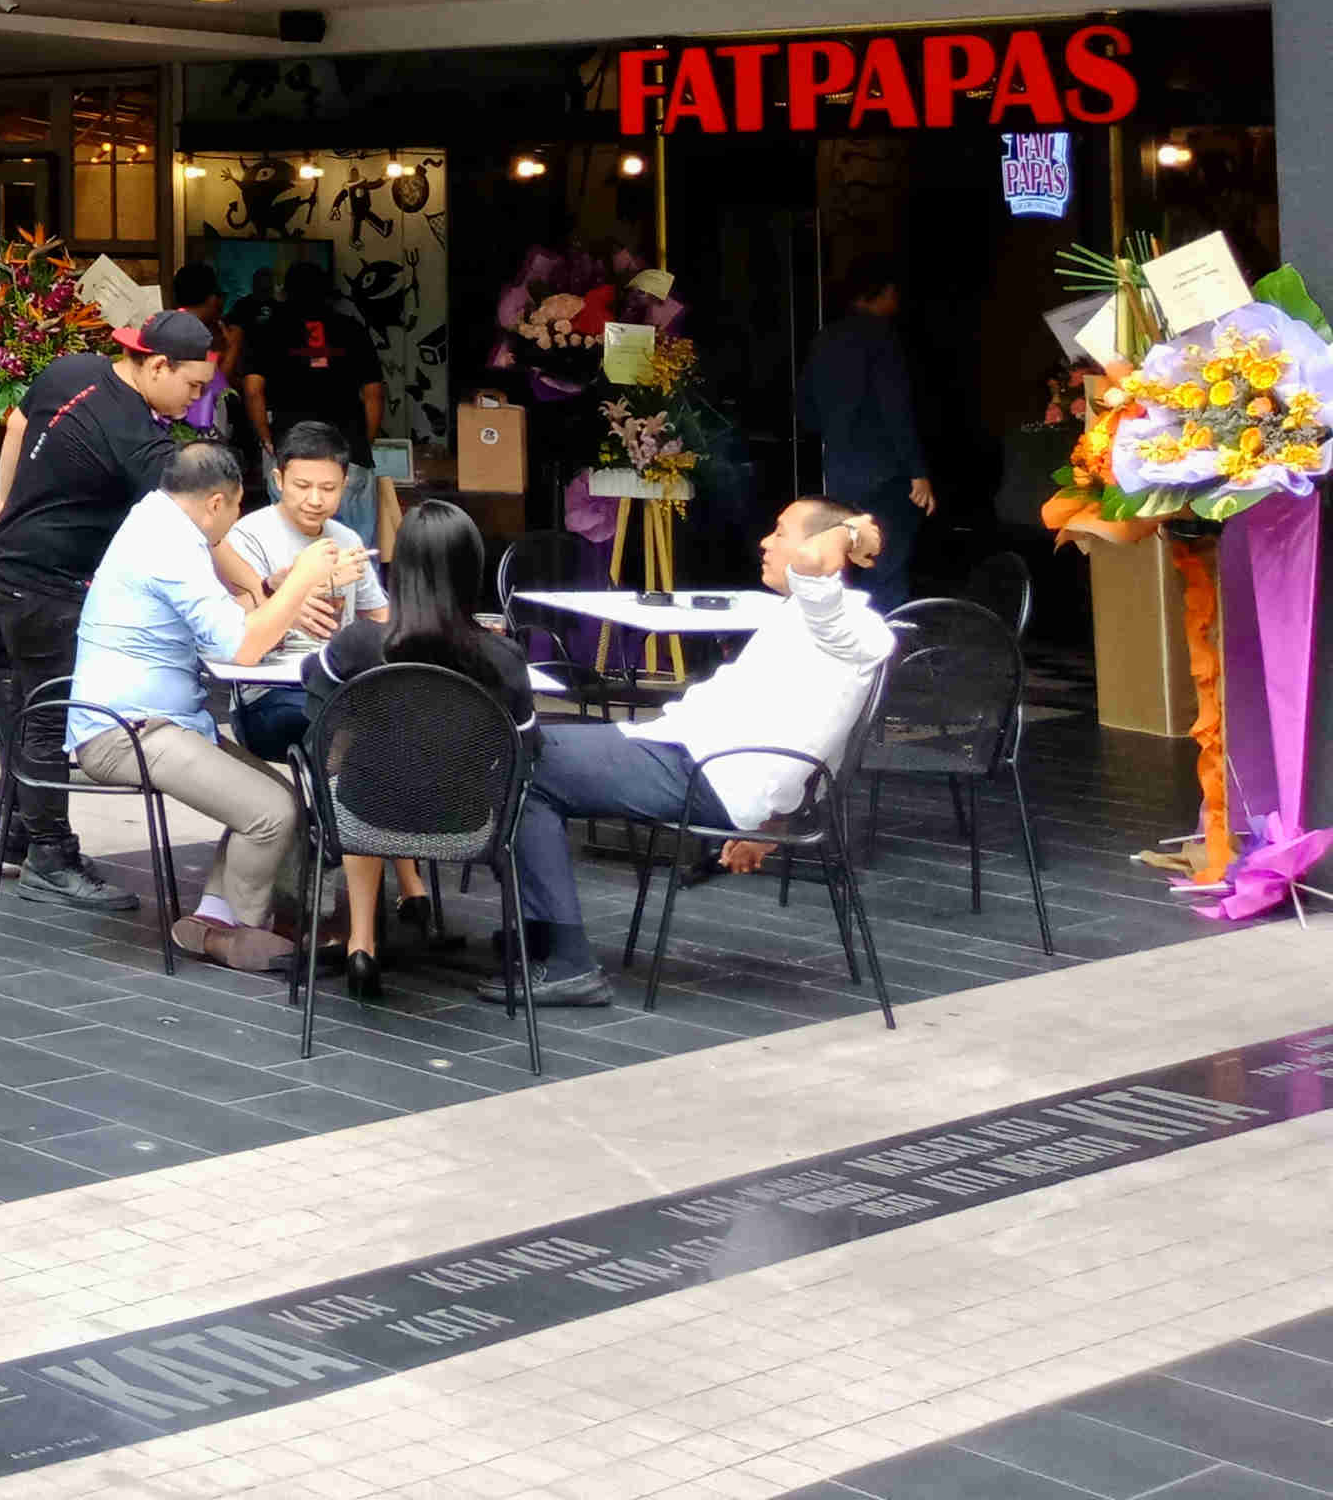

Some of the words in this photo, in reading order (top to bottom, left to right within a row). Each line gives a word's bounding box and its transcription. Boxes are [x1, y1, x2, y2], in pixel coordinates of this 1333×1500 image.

[618, 24, 1140, 136] FATPAPAS
[1004, 161, 1066, 197] PAPAS
[1039, 1084, 1270, 1142] KITA
[844, 1133, 1007, 1178] MENGATA
[970, 1116, 1071, 1145] KITA
[912, 1167, 1019, 1197] KITA
[978, 1133, 1142, 1179] MENGATA
[409, 1257, 532, 1294] KATA
[497, 1236, 612, 1271] KITA
[565, 1257, 683, 1293] KITA
[385, 1303, 516, 1345] KATA
[40, 1325, 363, 1420] KATA
